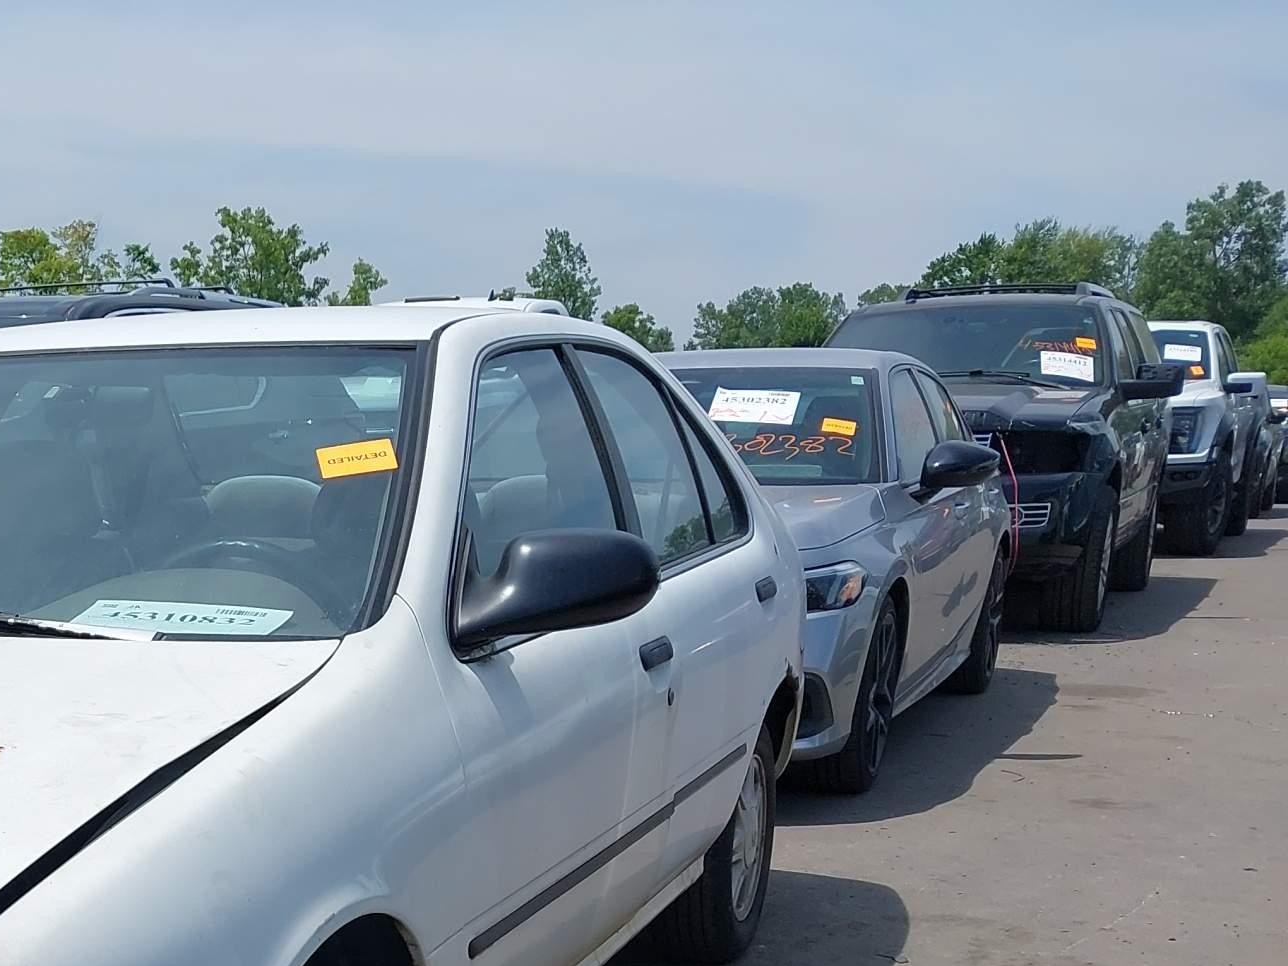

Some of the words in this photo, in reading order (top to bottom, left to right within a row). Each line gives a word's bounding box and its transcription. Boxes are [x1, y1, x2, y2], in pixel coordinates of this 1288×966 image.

[722, 396, 788, 405] 45302382
[327, 450, 388, 466] DETAILED
[102, 610, 256, 627] 45310832
